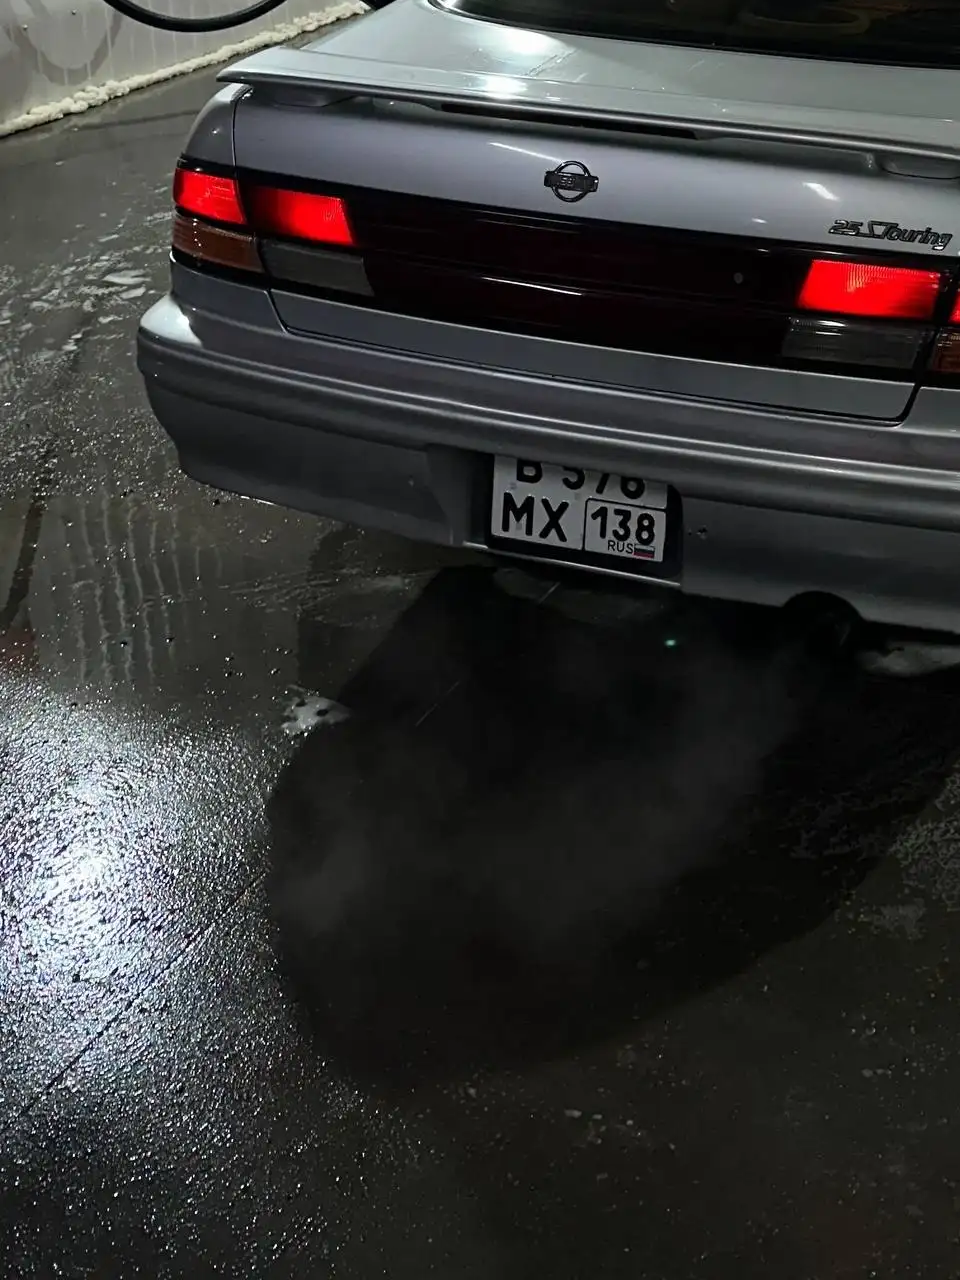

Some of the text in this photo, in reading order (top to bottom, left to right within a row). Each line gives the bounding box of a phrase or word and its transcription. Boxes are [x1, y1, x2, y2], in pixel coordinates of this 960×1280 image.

[828, 219, 863, 237] 25
[591, 506, 655, 546] 138
[607, 539, 634, 554] RUS
